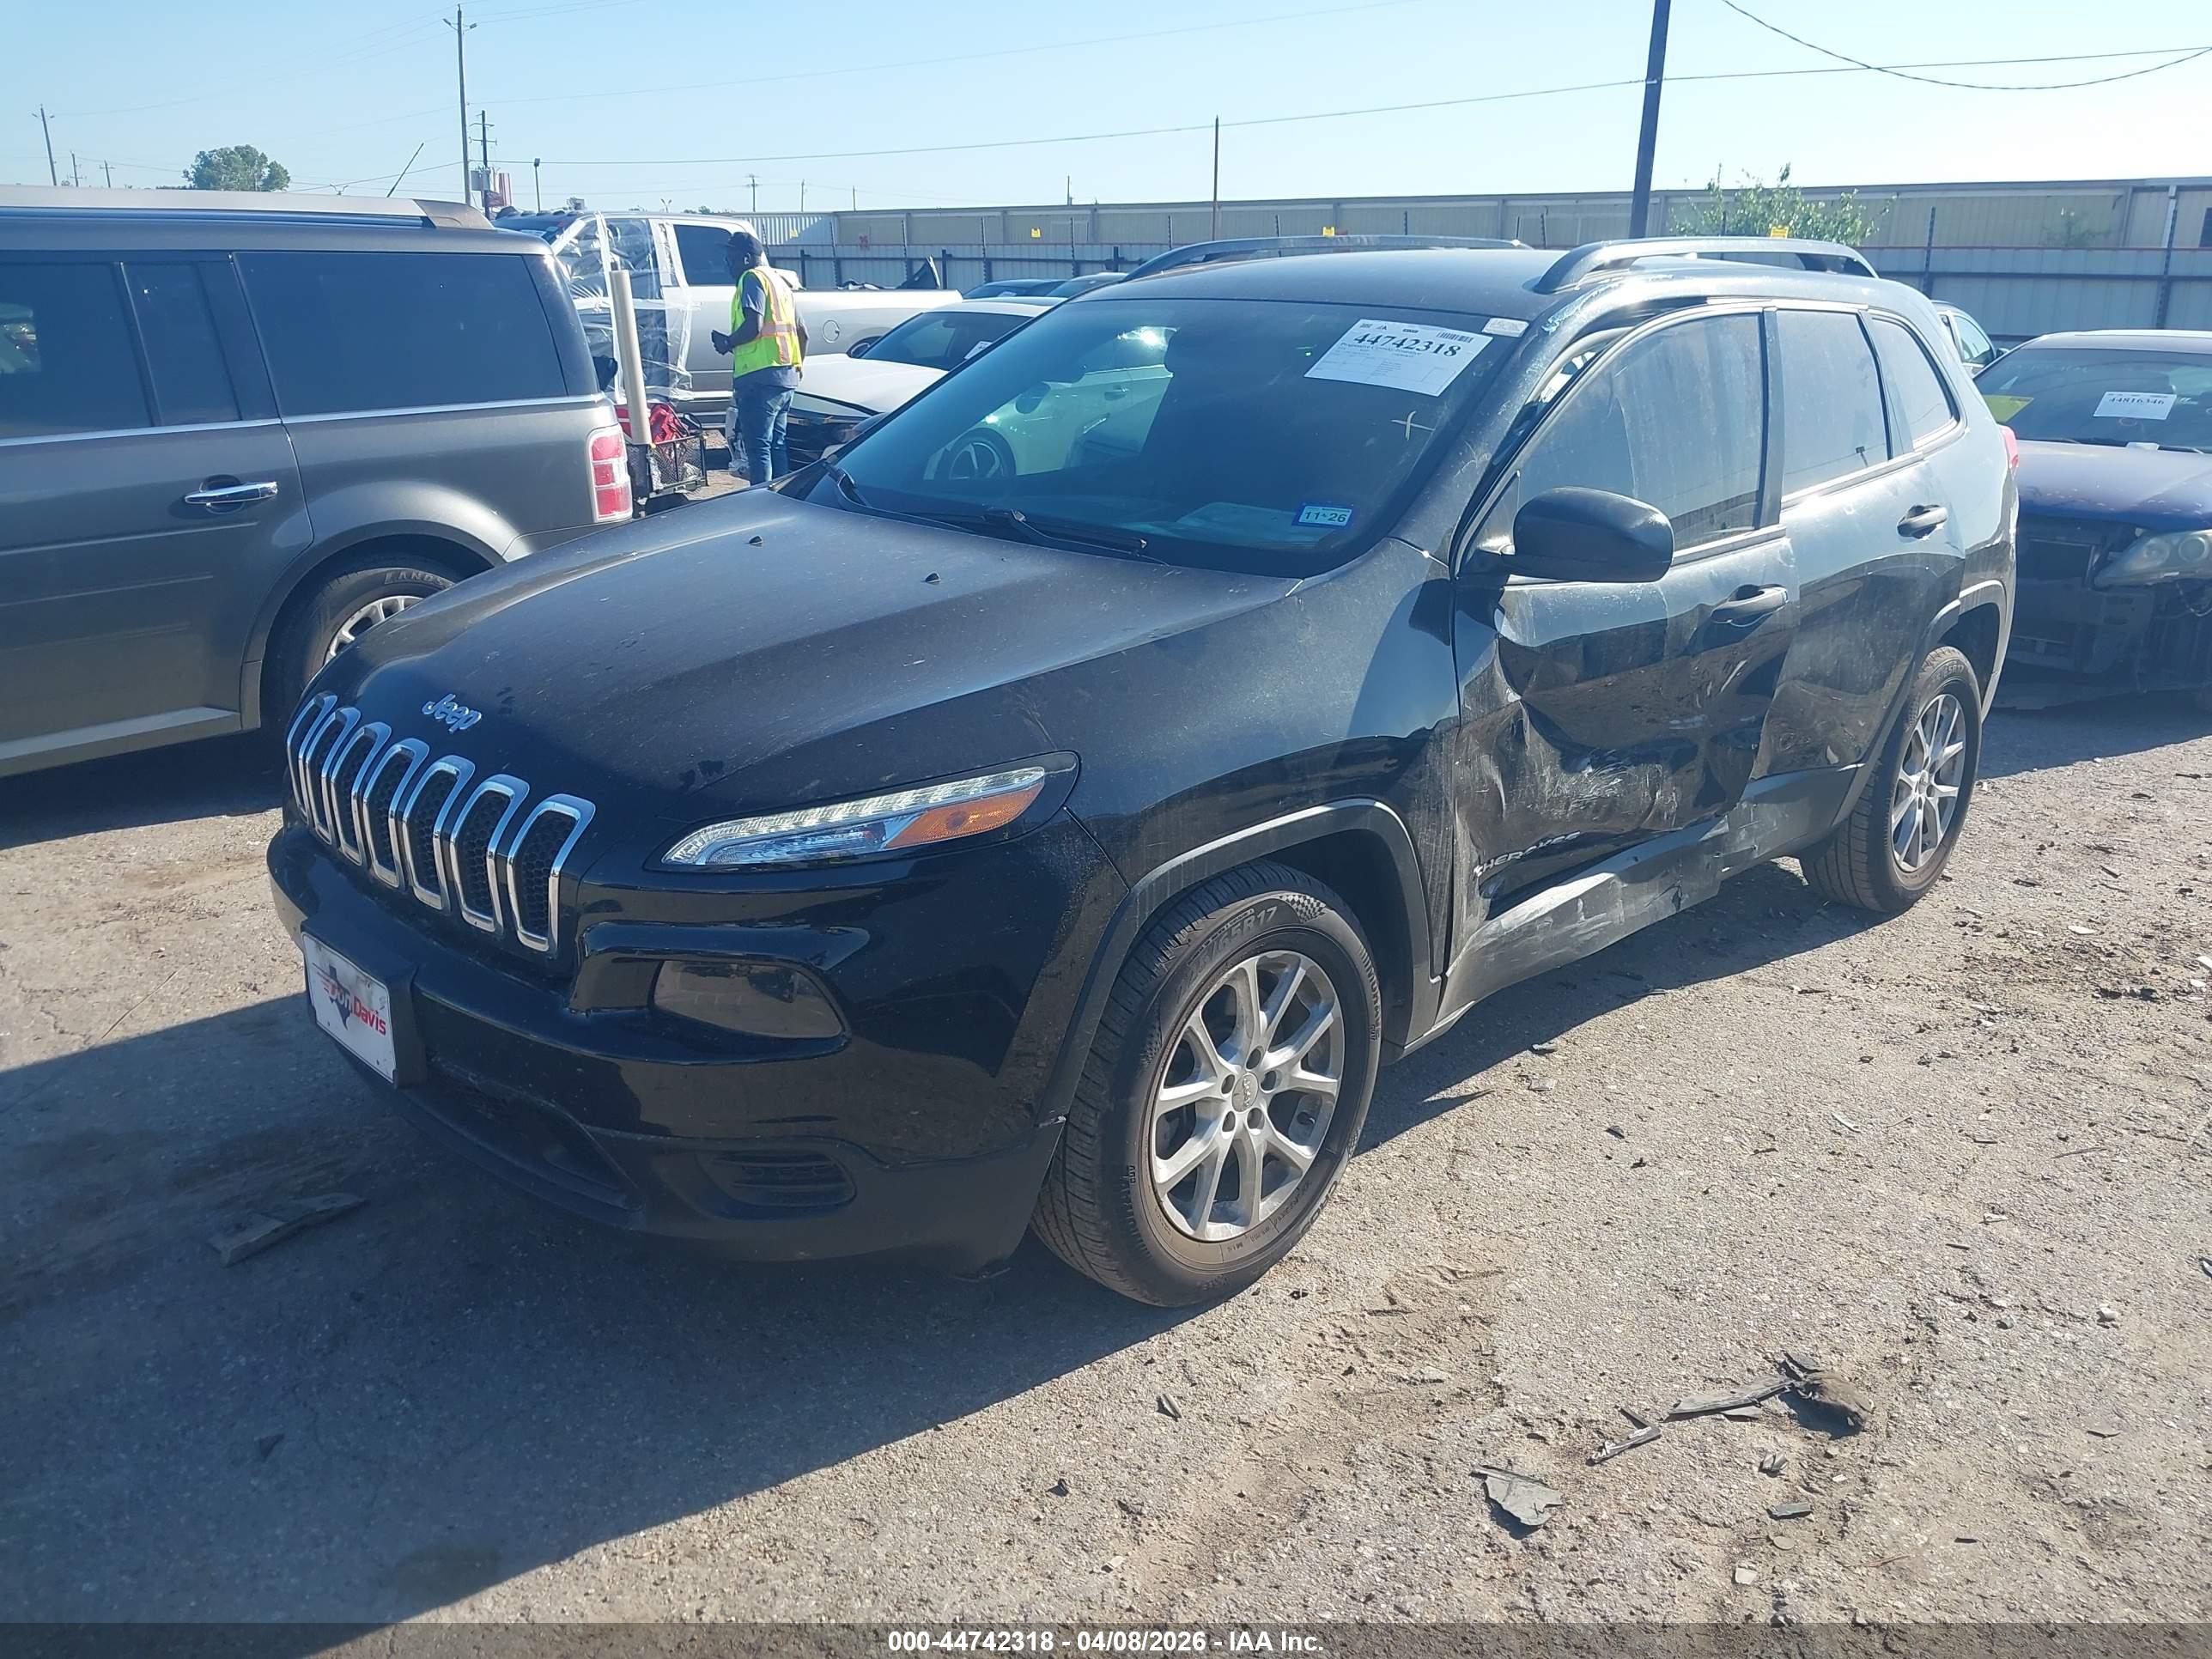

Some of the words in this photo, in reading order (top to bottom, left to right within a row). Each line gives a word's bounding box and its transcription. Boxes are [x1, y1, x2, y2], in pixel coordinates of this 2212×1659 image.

[1353, 332, 1462, 357] 44742318
[422, 693, 482, 734] Jeep
[353, 995, 386, 1036] Davis
